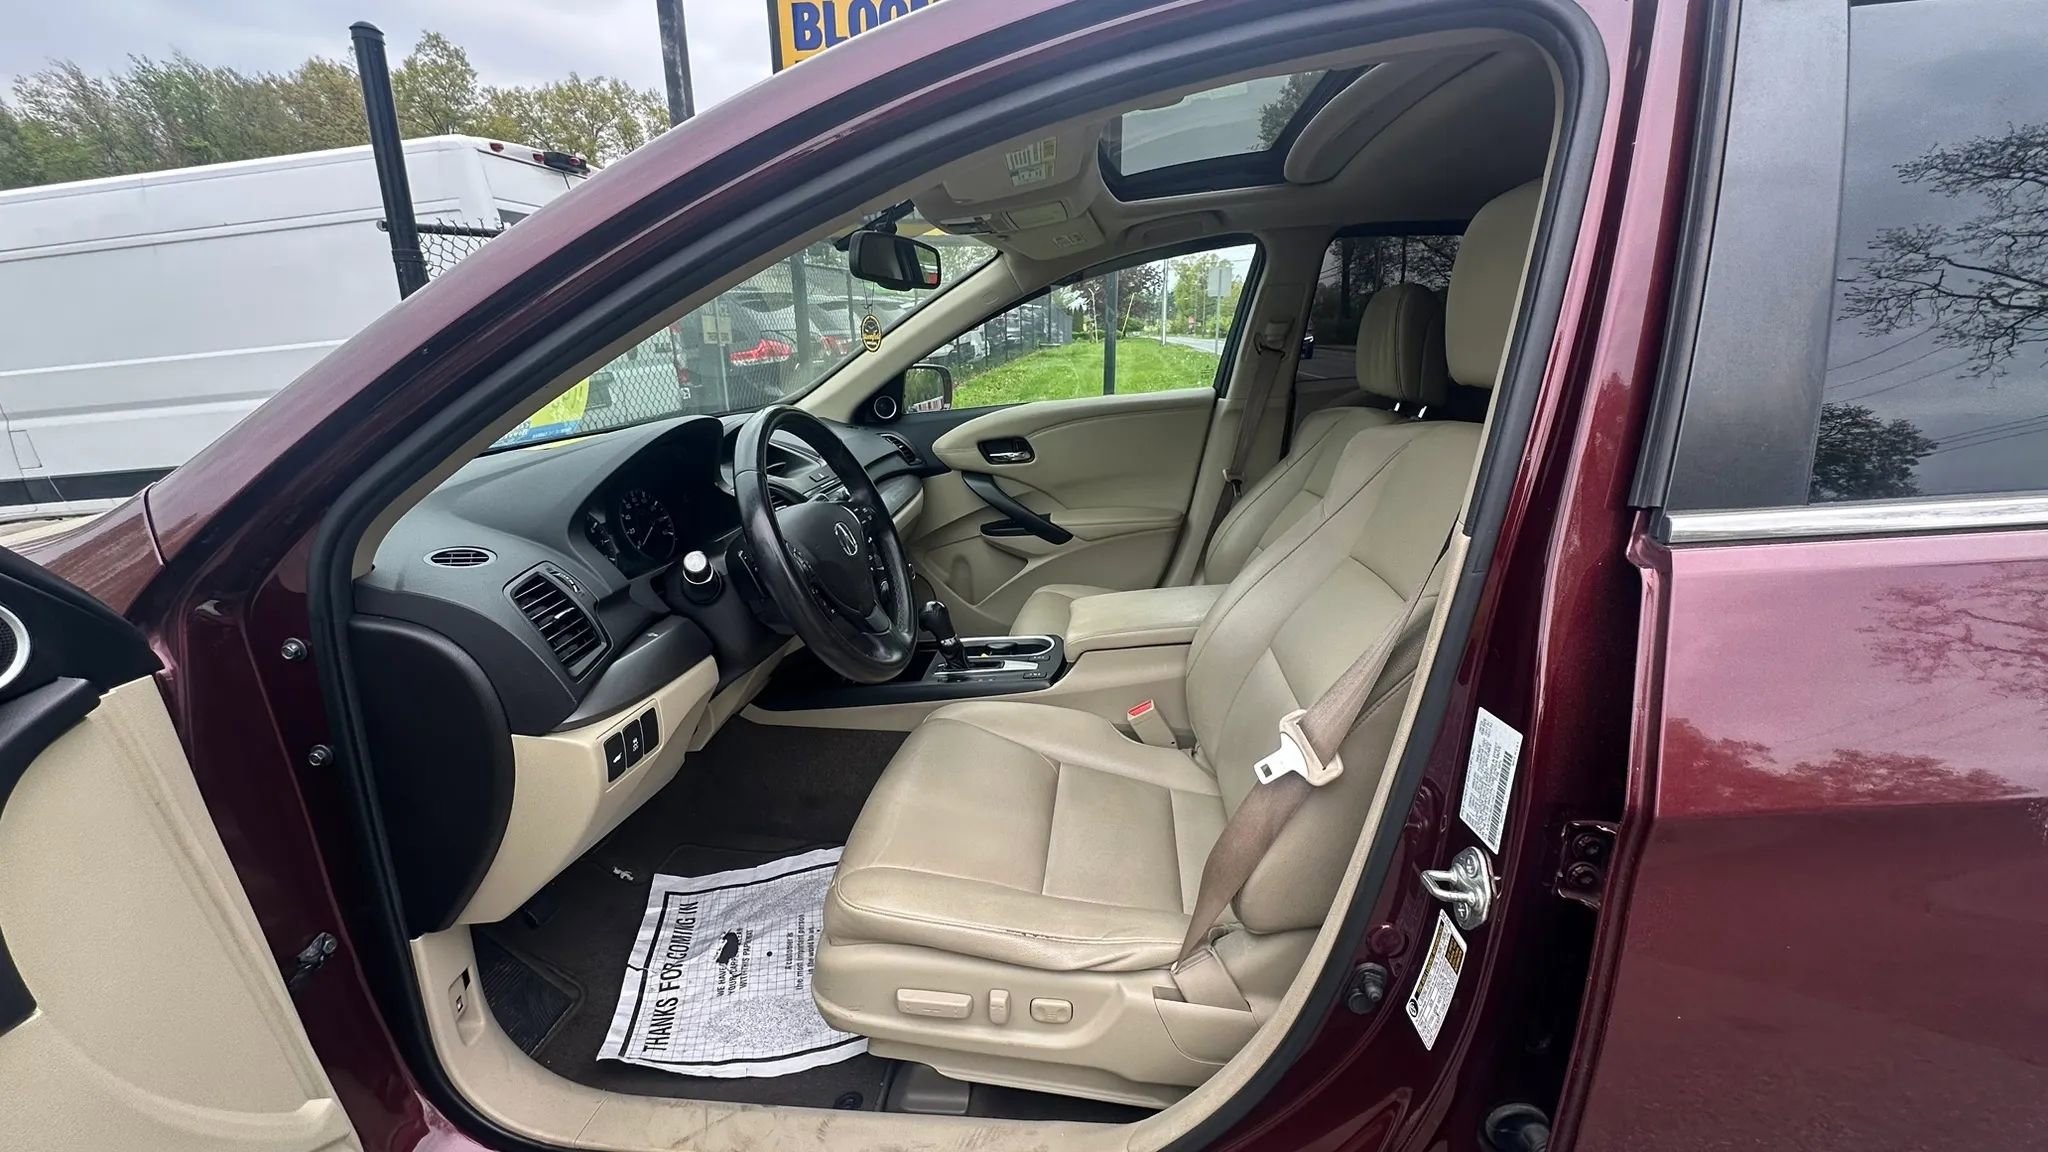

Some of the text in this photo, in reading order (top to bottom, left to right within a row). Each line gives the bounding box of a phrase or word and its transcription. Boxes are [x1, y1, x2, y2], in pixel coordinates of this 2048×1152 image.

[785, 938, 793, 965] customer
[796, 935, 805, 961] important
[643, 901, 699, 1052] THANKS FOR COMING IN
[716, 966, 726, 997] WE HAVE
[727, 976, 737, 996] YOUR
[795, 979, 804, 991] the
